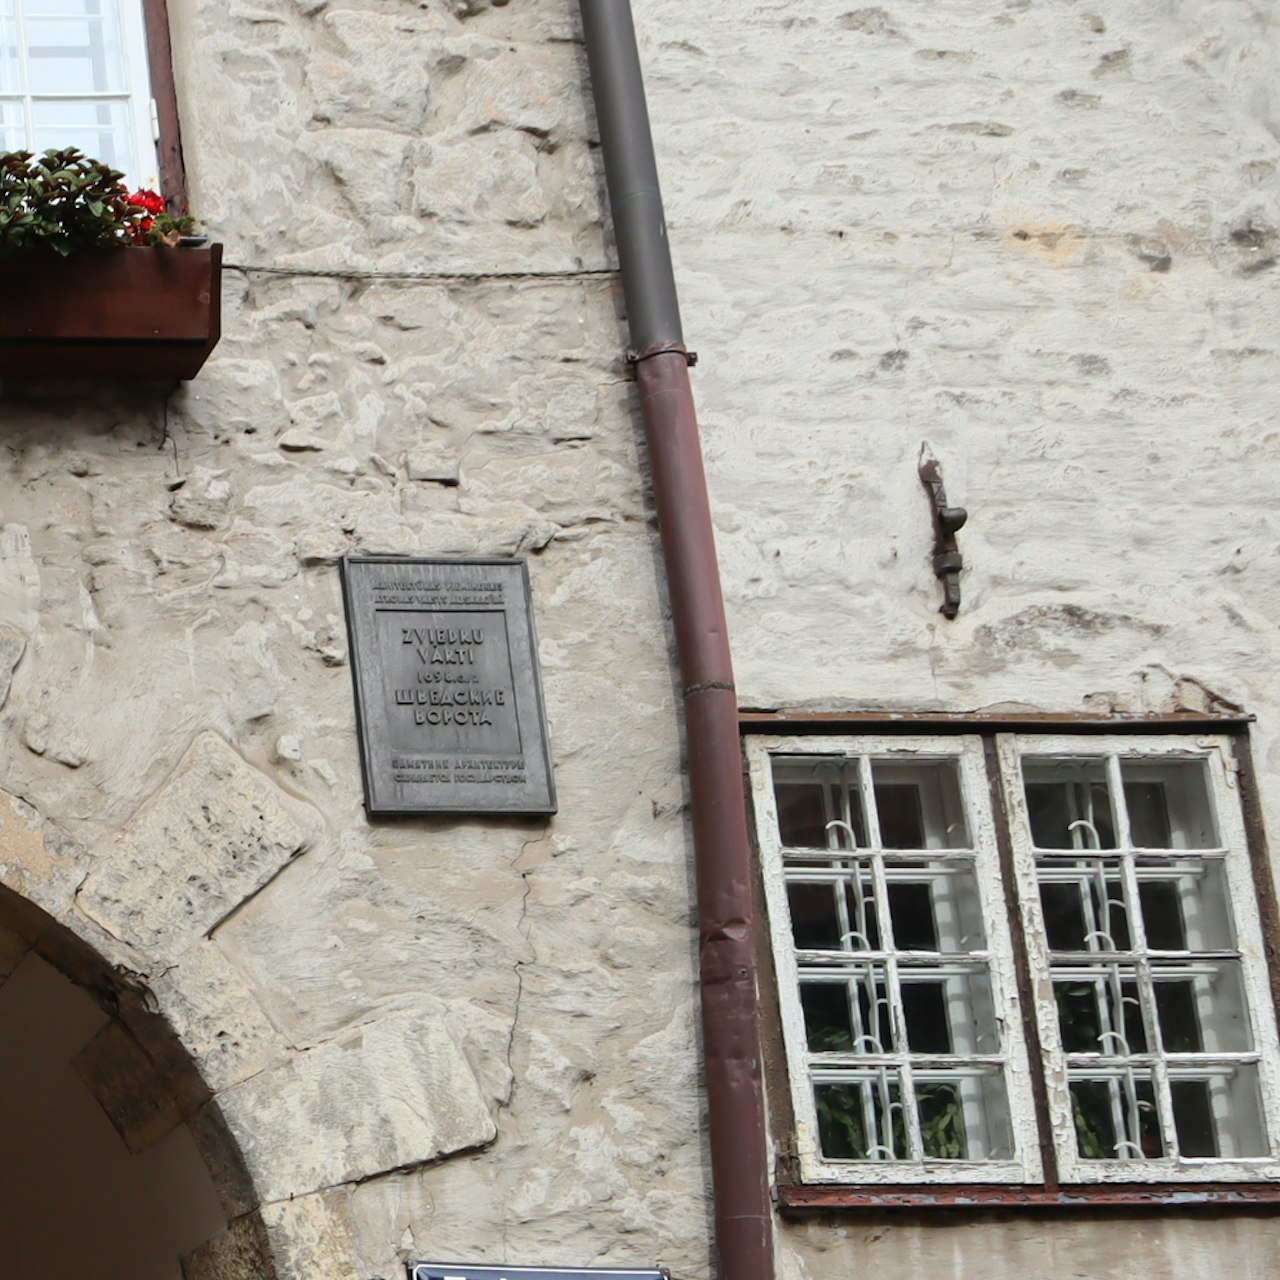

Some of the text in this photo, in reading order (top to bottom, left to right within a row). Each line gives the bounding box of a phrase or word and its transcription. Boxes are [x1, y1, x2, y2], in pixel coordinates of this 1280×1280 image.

[402, 629, 484, 645] ZVIEDRU
[395, 689, 505, 707] ШВЕДСКИЕ
[414, 709, 492, 726] ВОРОТА
